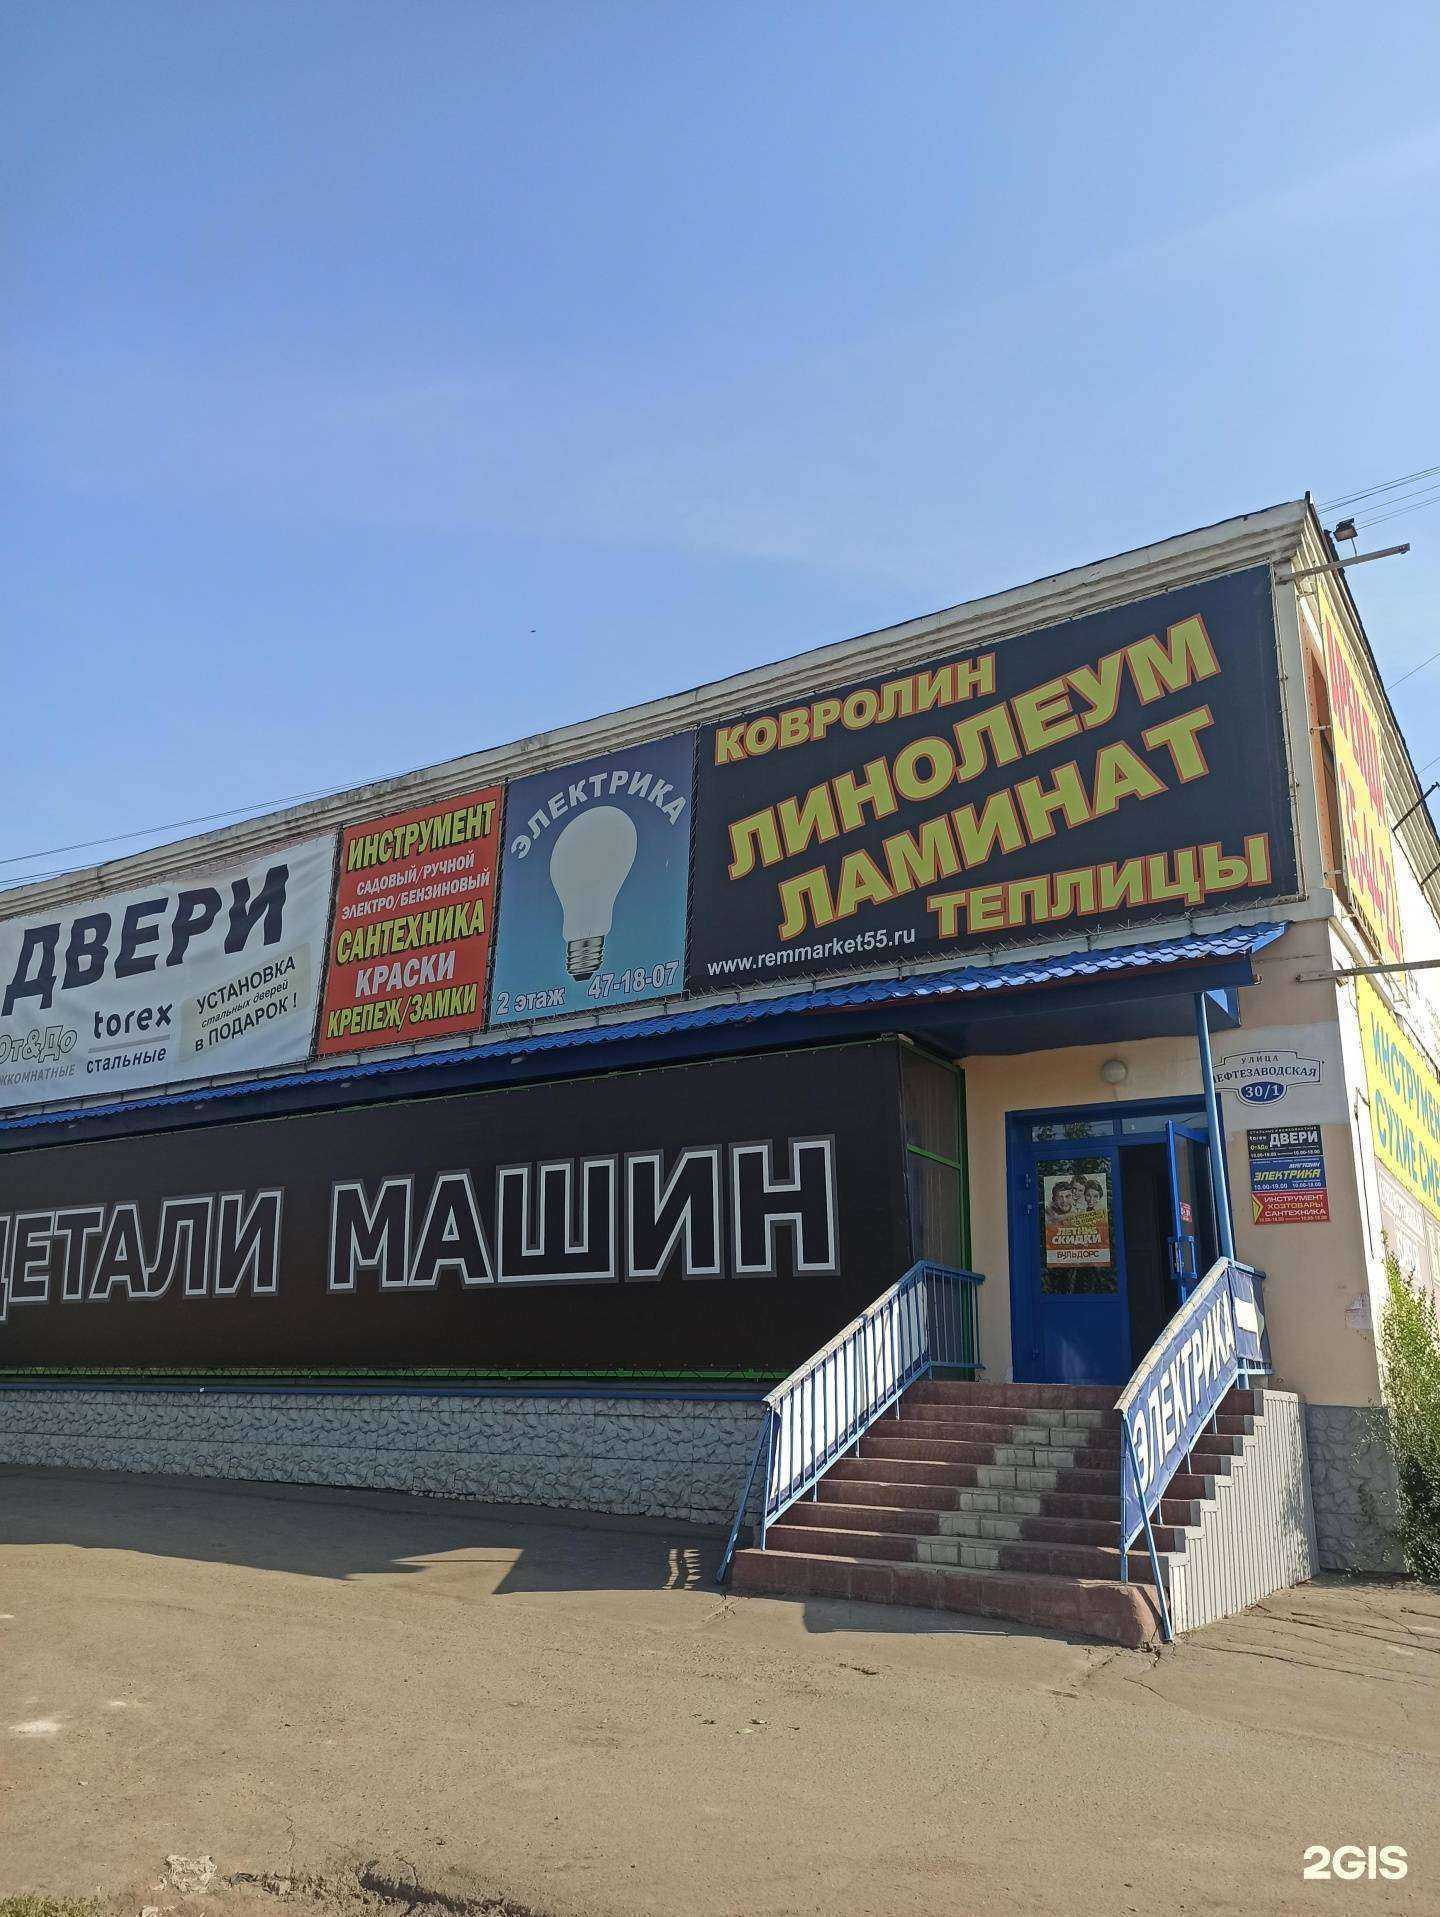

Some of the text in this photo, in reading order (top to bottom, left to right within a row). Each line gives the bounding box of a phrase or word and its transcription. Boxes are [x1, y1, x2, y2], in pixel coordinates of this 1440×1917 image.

[714, 652, 998, 766] КОВРОЛИН
[728, 612, 1222, 881] ЛИНОЛЕУМ
[347, 801, 496, 873] ИНСТРУМЕНТ
[511, 770, 688, 859] ЭЛЕКТРИКА
[778, 704, 1215, 941] ЛАМИНАТ
[341, 867, 490, 920] ЭЛЕКТРО/БЕНЗИНОВЫЙ
[356, 850, 475, 896] САДОВЫЙ/РУЧНОЙ
[926, 833, 1271, 939] ТЕПЛИЦЫ
[1, 863, 289, 1017] ДВЕРИ
[336, 899, 485, 965] САНТЕХНИКА
[707, 928, 916, 976] www.remmarket55.ru
[197, 956, 296, 1014] УСТАНОВКА
[355, 950, 456, 998] КРАСКИ
[588, 960, 679, 999] 47-18-07
[94, 1003, 173, 1039] torex
[201, 980, 289, 1028] стальных дверей
[208, 996, 288, 1045] ПОДАРОК
[326, 983, 478, 1039] КРЕПЕЖ/ЗАМКИ
[496, 987, 566, 1015] 2 этаж
[86, 1047, 167, 1074] стальные
[1241, 1054, 1279, 1065] УЛИЦА
[1245, 1084, 1280, 1099] 30/1
[1270, 1131, 1318, 1147] ДВЕРИ
[1254, 1169, 1320, 1181] ЭЛЕКТРИКА
[1264, 1194, 1324, 1203] ИНСТРУМЕНТ
[0, 1137, 840, 1320] ЕТАЛИ МАШИН
[1264, 1208, 1326, 1217] САНТЕХНИКА
[1267, 1201, 1323, 1210] ХОЗТОВАРЫ
[1132, 1290, 1236, 1497] ЭЛЕКТРИКА
